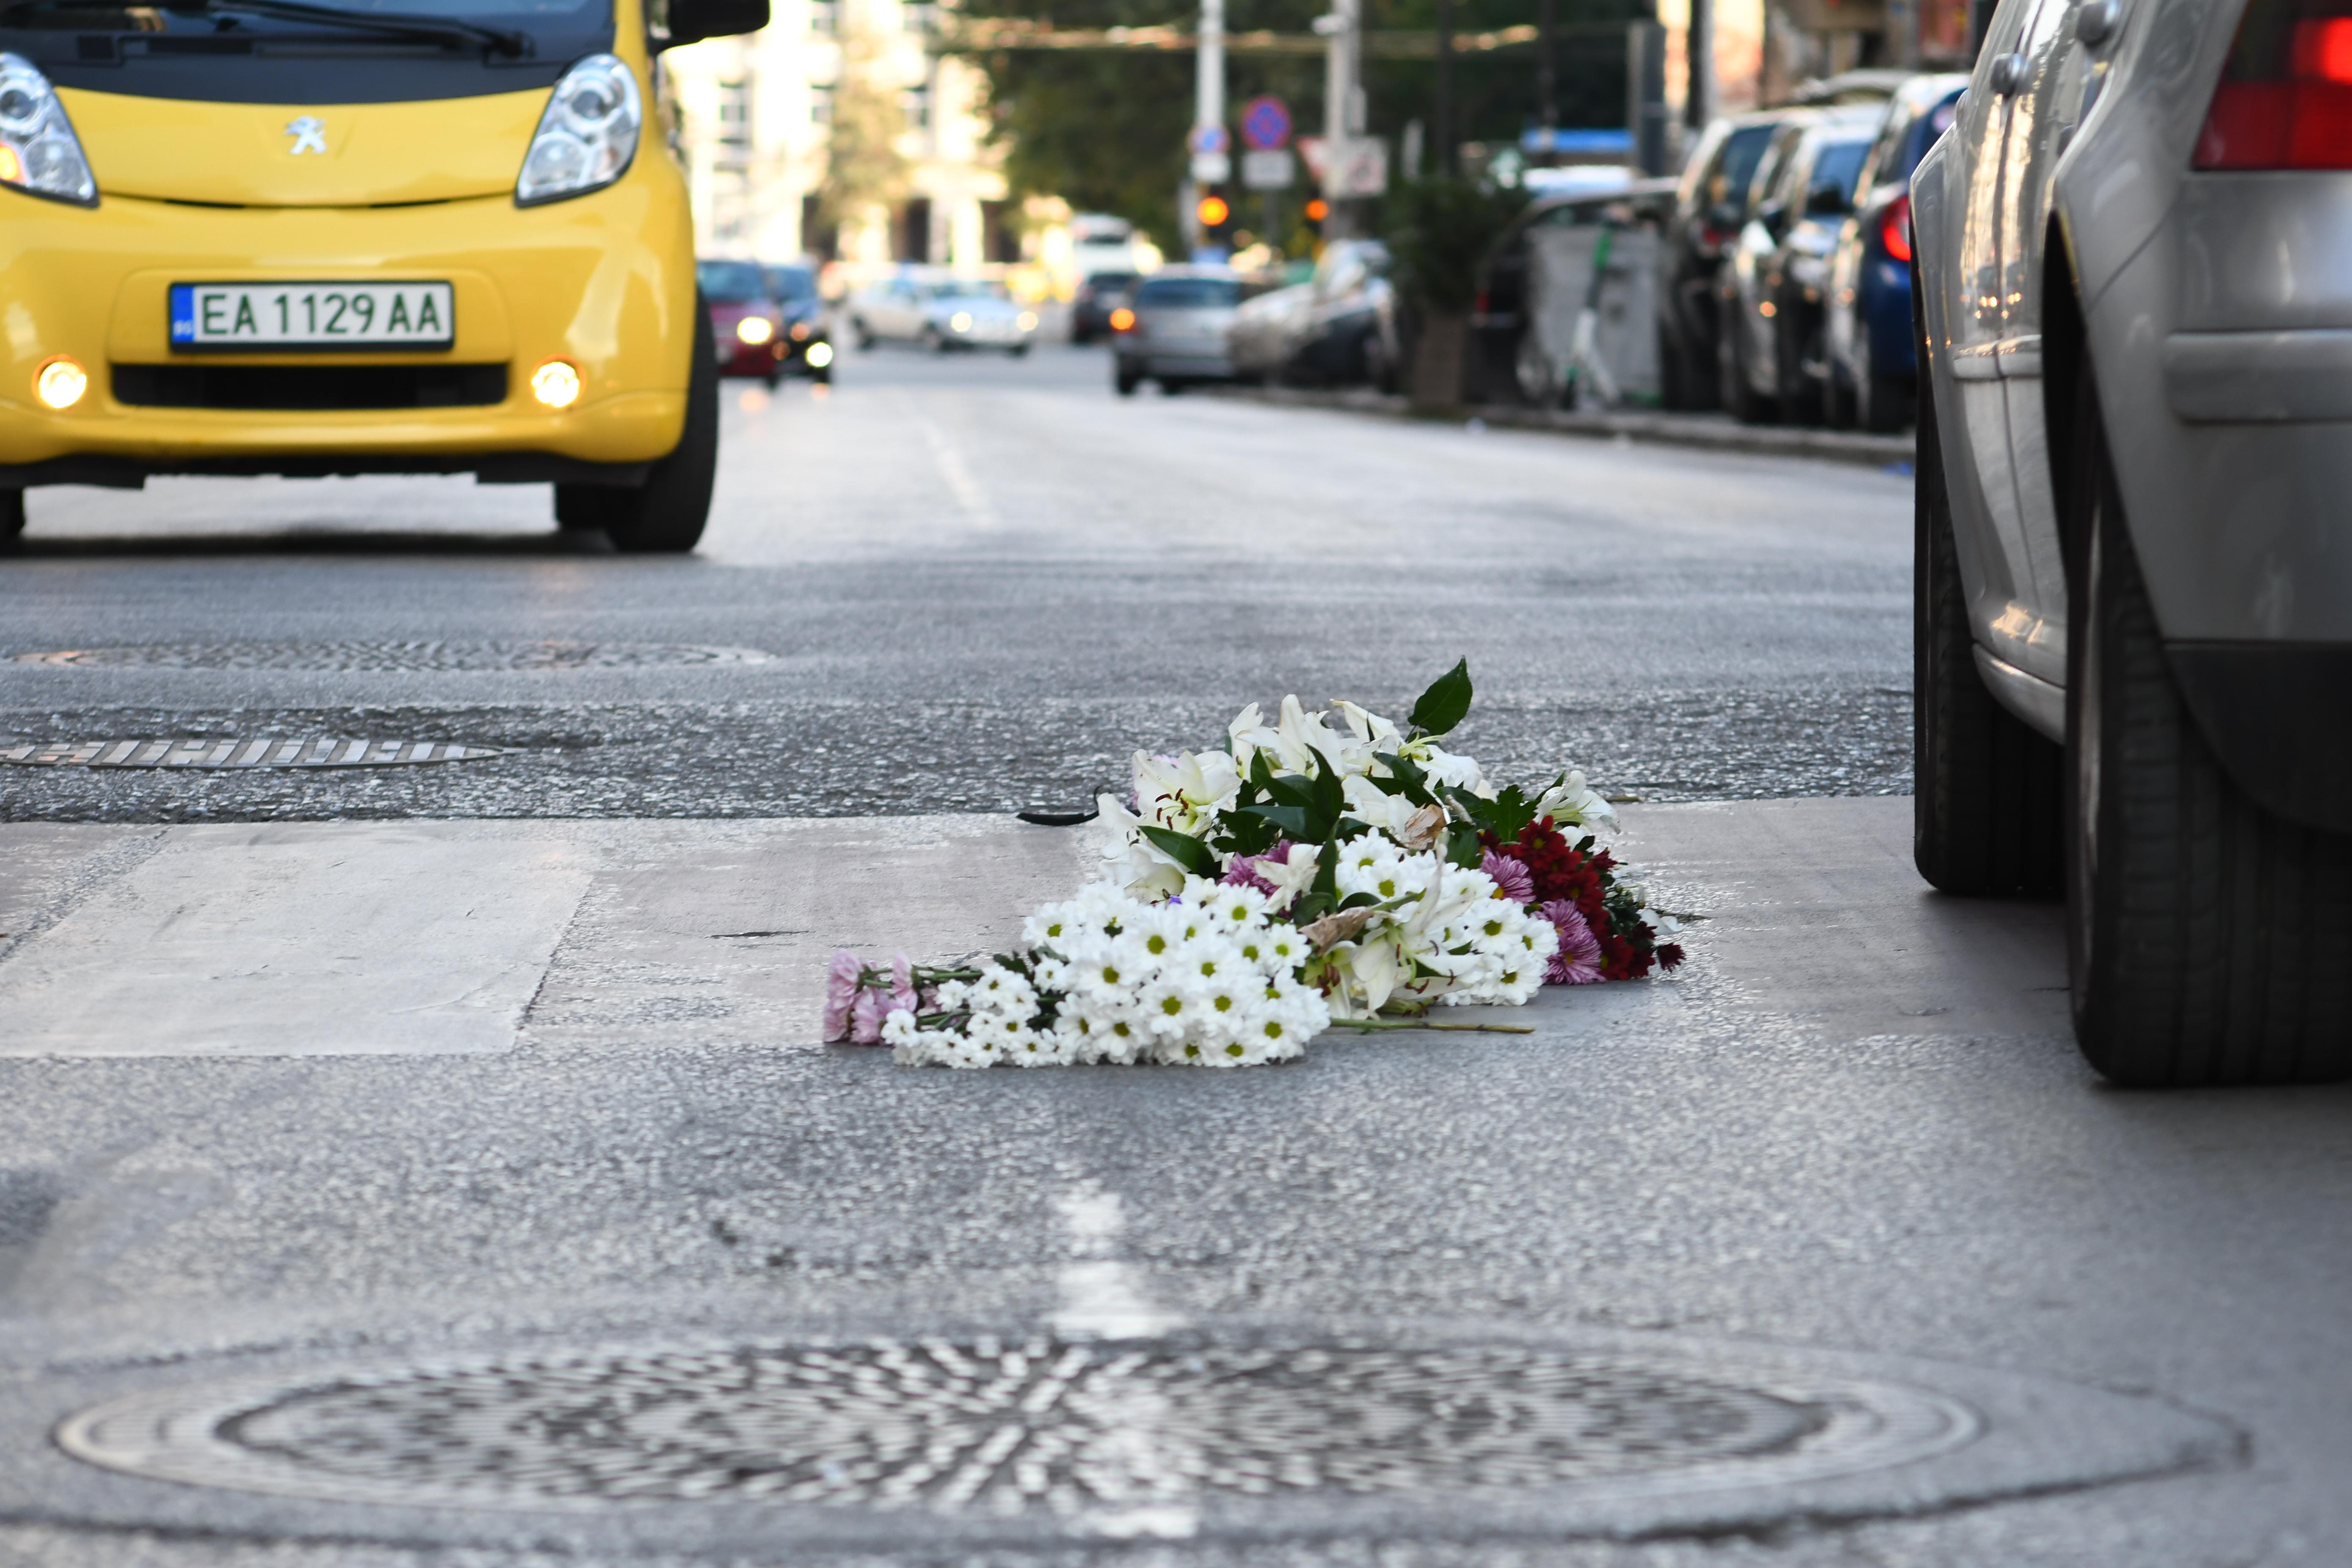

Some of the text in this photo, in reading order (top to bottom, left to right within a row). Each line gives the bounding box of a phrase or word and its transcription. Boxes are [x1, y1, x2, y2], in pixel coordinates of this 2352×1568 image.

[202, 293, 441, 334] EA 1129 AA
